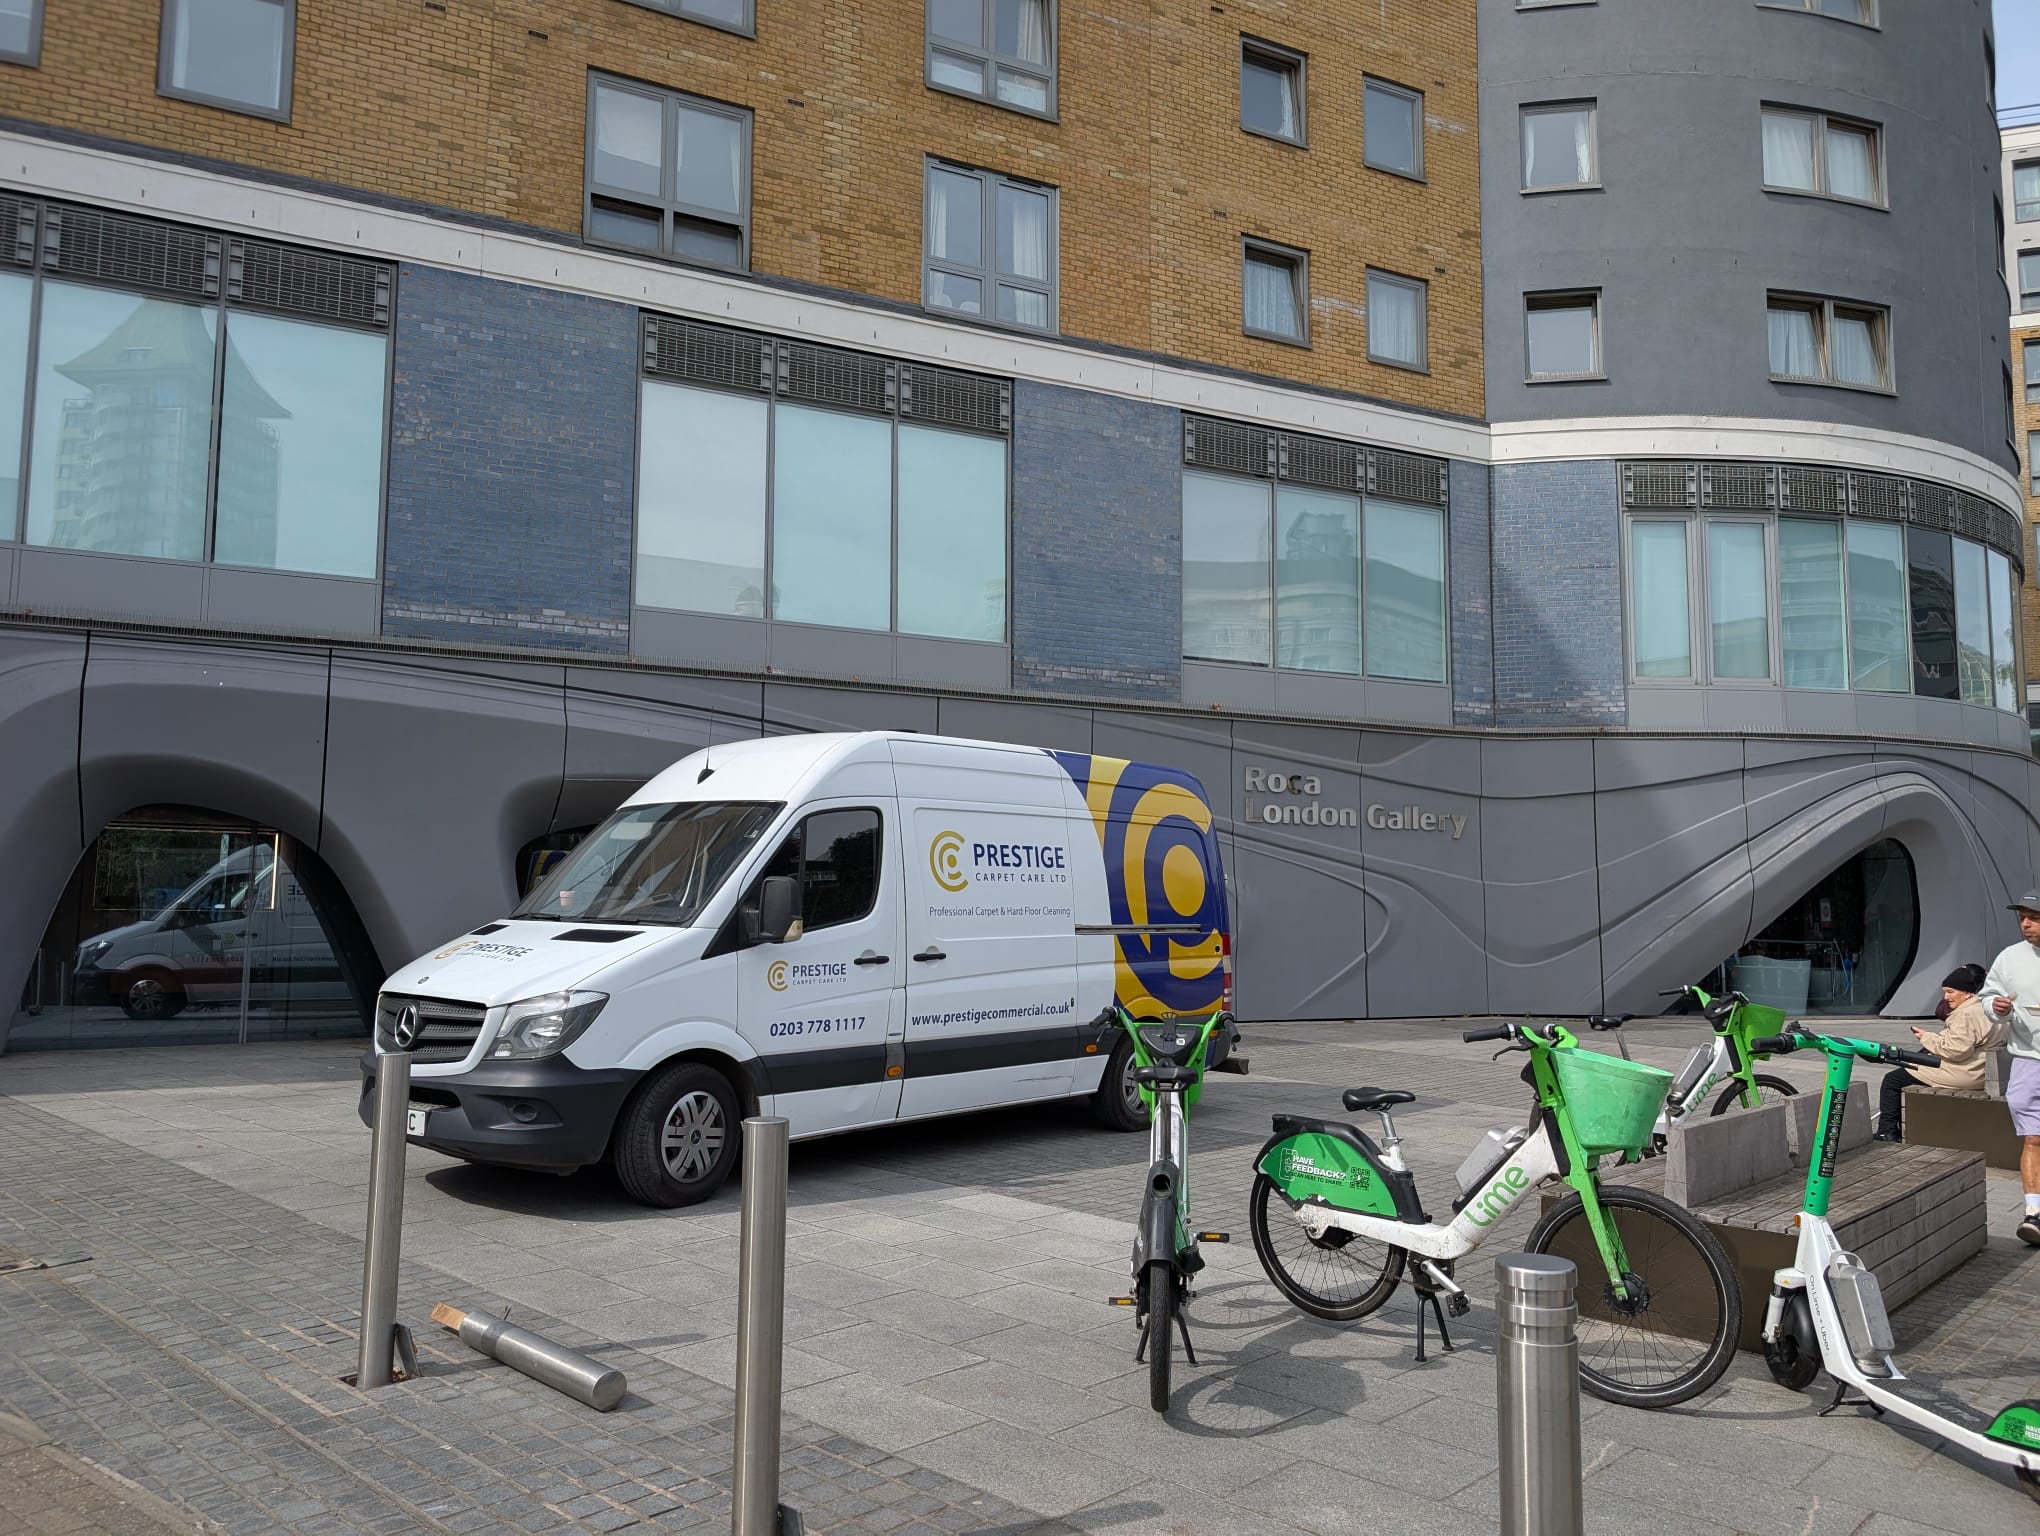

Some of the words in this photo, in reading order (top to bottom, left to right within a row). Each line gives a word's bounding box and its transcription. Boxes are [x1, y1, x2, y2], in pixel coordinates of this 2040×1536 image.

[1244, 766, 1322, 795] Roca
[1244, 796, 1358, 828] London
[1367, 803, 1468, 840] Gallery
[973, 843, 1065, 869] PRESTIGE
[975, 872, 1015, 882] CARPET
[1020, 873, 1046, 883] CARE
[1050, 874, 1067, 883] LTD
[929, 906, 974, 917] Professional
[975, 906, 999, 918] Carpet
[1000, 906, 1006, 916] &
[1006, 906, 1023, 916] Hard
[1024, 906, 1042, 916] Floor
[1042, 906, 1071, 918] Cleaning
[792, 963, 847, 978] PRESTIGE
[792, 978, 816, 986] CARPET
[911, 1002, 1070, 1026] www.prestigecommercial.co.uk
[770, 1021, 803, 1036] 0203
[807, 1019, 831, 1034] 778
[835, 1016, 866, 1031] 1117
[1292, 1155, 1315, 1166] HAVE
[1291, 1163, 1347, 1180] FEEDBACK?
[1317, 1175, 1325, 1183] TO
[1463, 1166, 1530, 1227] Lime
[1820, 1326, 1830, 1351] Uber
